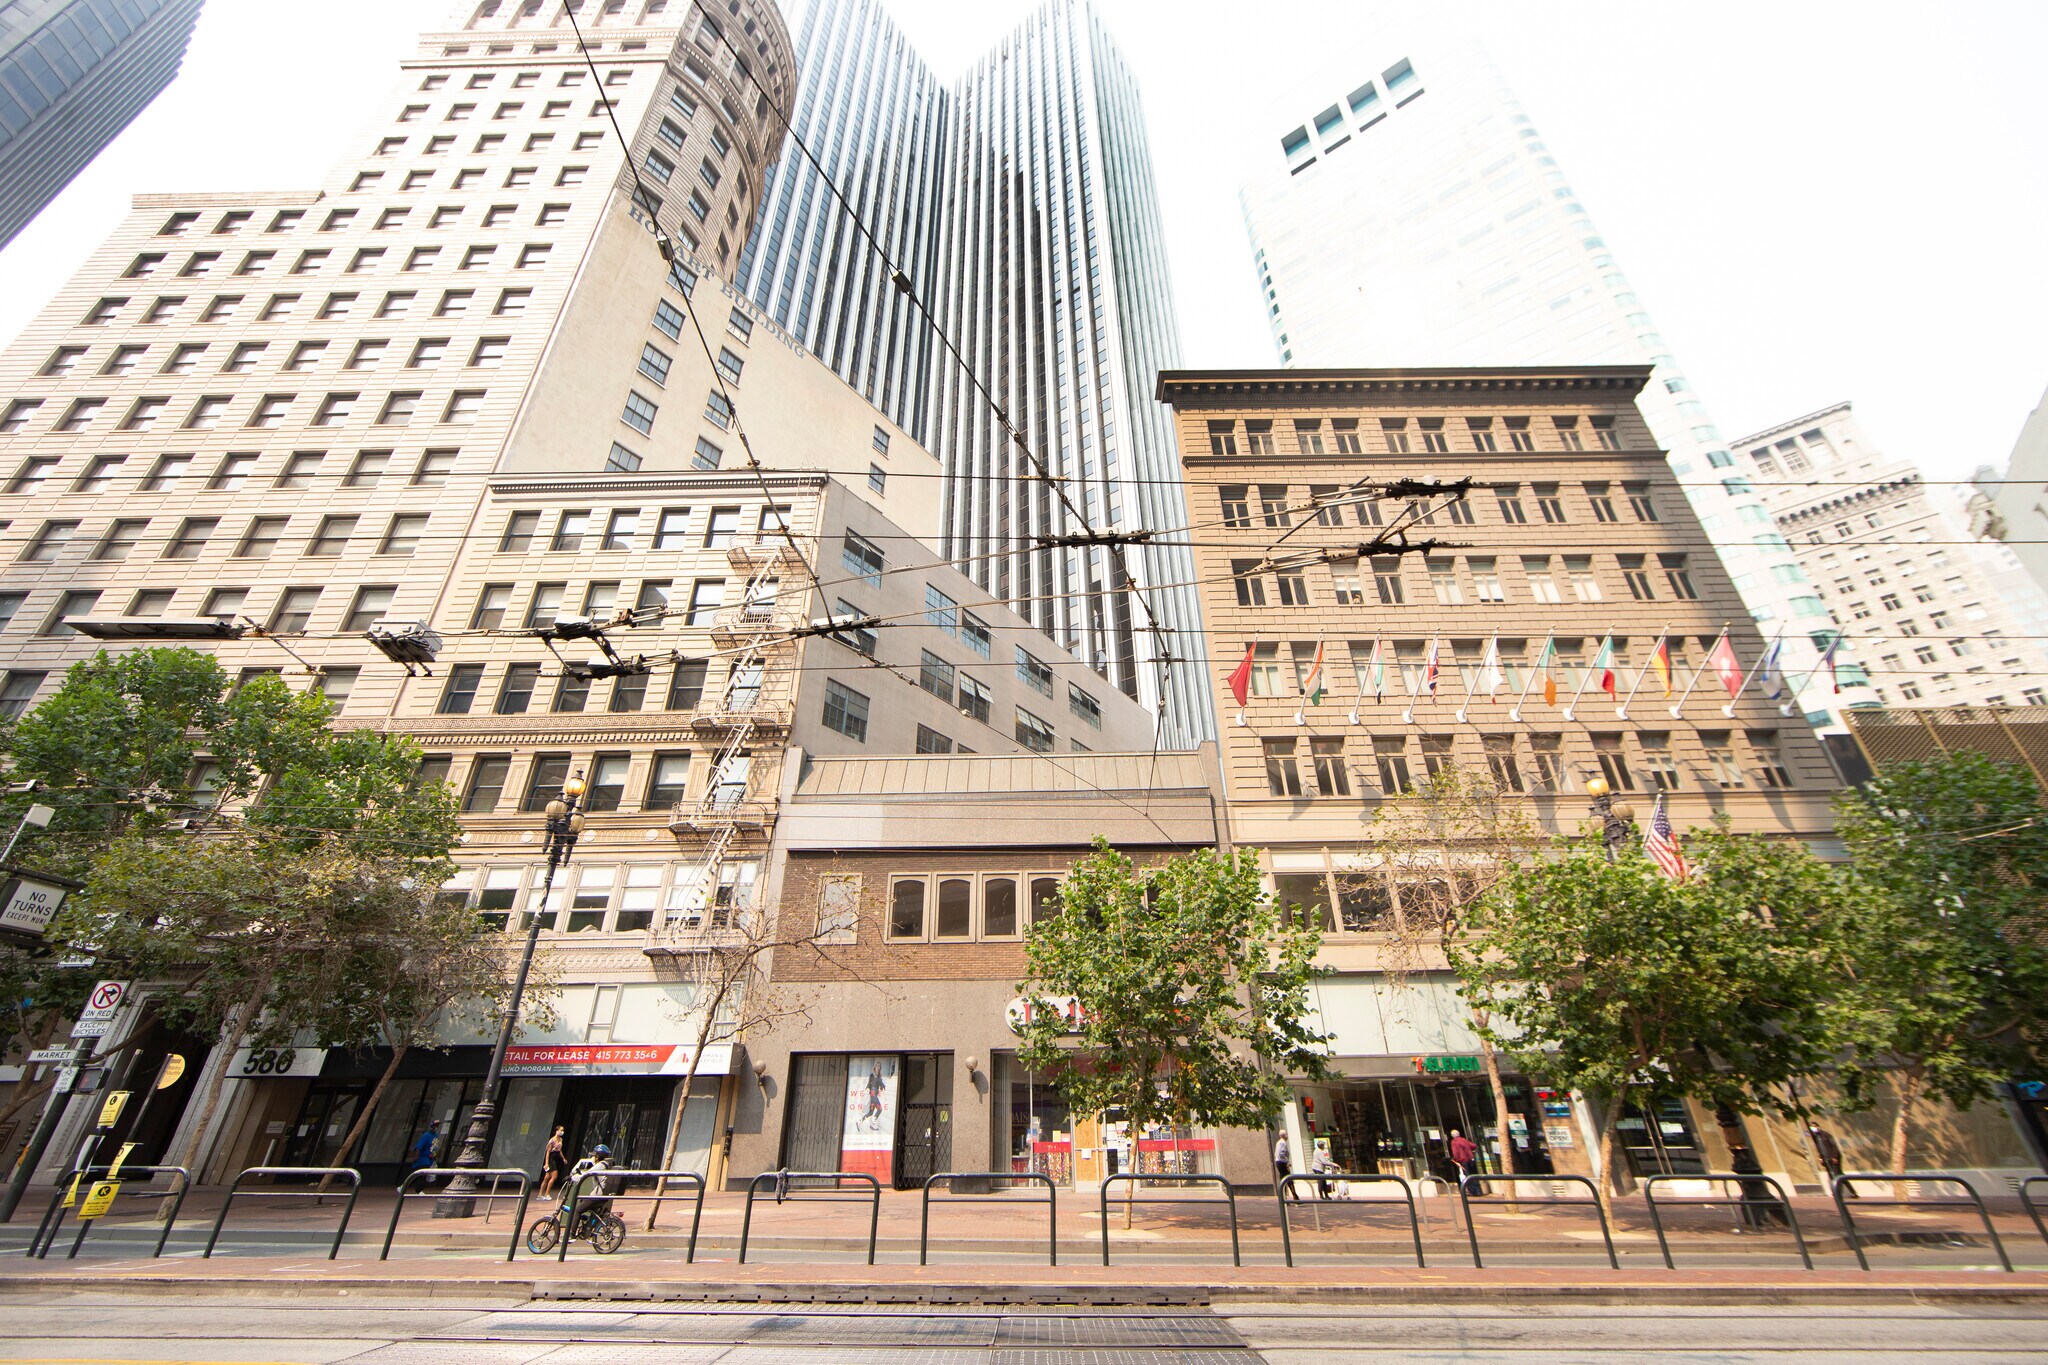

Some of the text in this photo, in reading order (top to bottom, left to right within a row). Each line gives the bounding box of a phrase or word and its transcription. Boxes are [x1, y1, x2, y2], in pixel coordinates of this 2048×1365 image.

[627, 205, 805, 359] HOART BUILDING
[29, 891, 47, 902] NO
[13, 900, 52, 916] TURNS
[5, 911, 47, 925] EXCEPT MUNI
[36, 1051, 71, 1059] MARKET
[243, 1048, 296, 1074] 580
[504, 1050, 657, 1061] ETAIL FOR LEASE 415 773 3546
[1012, 1111, 1031, 1123] DAIS
[100, 1187, 109, 1195] K
